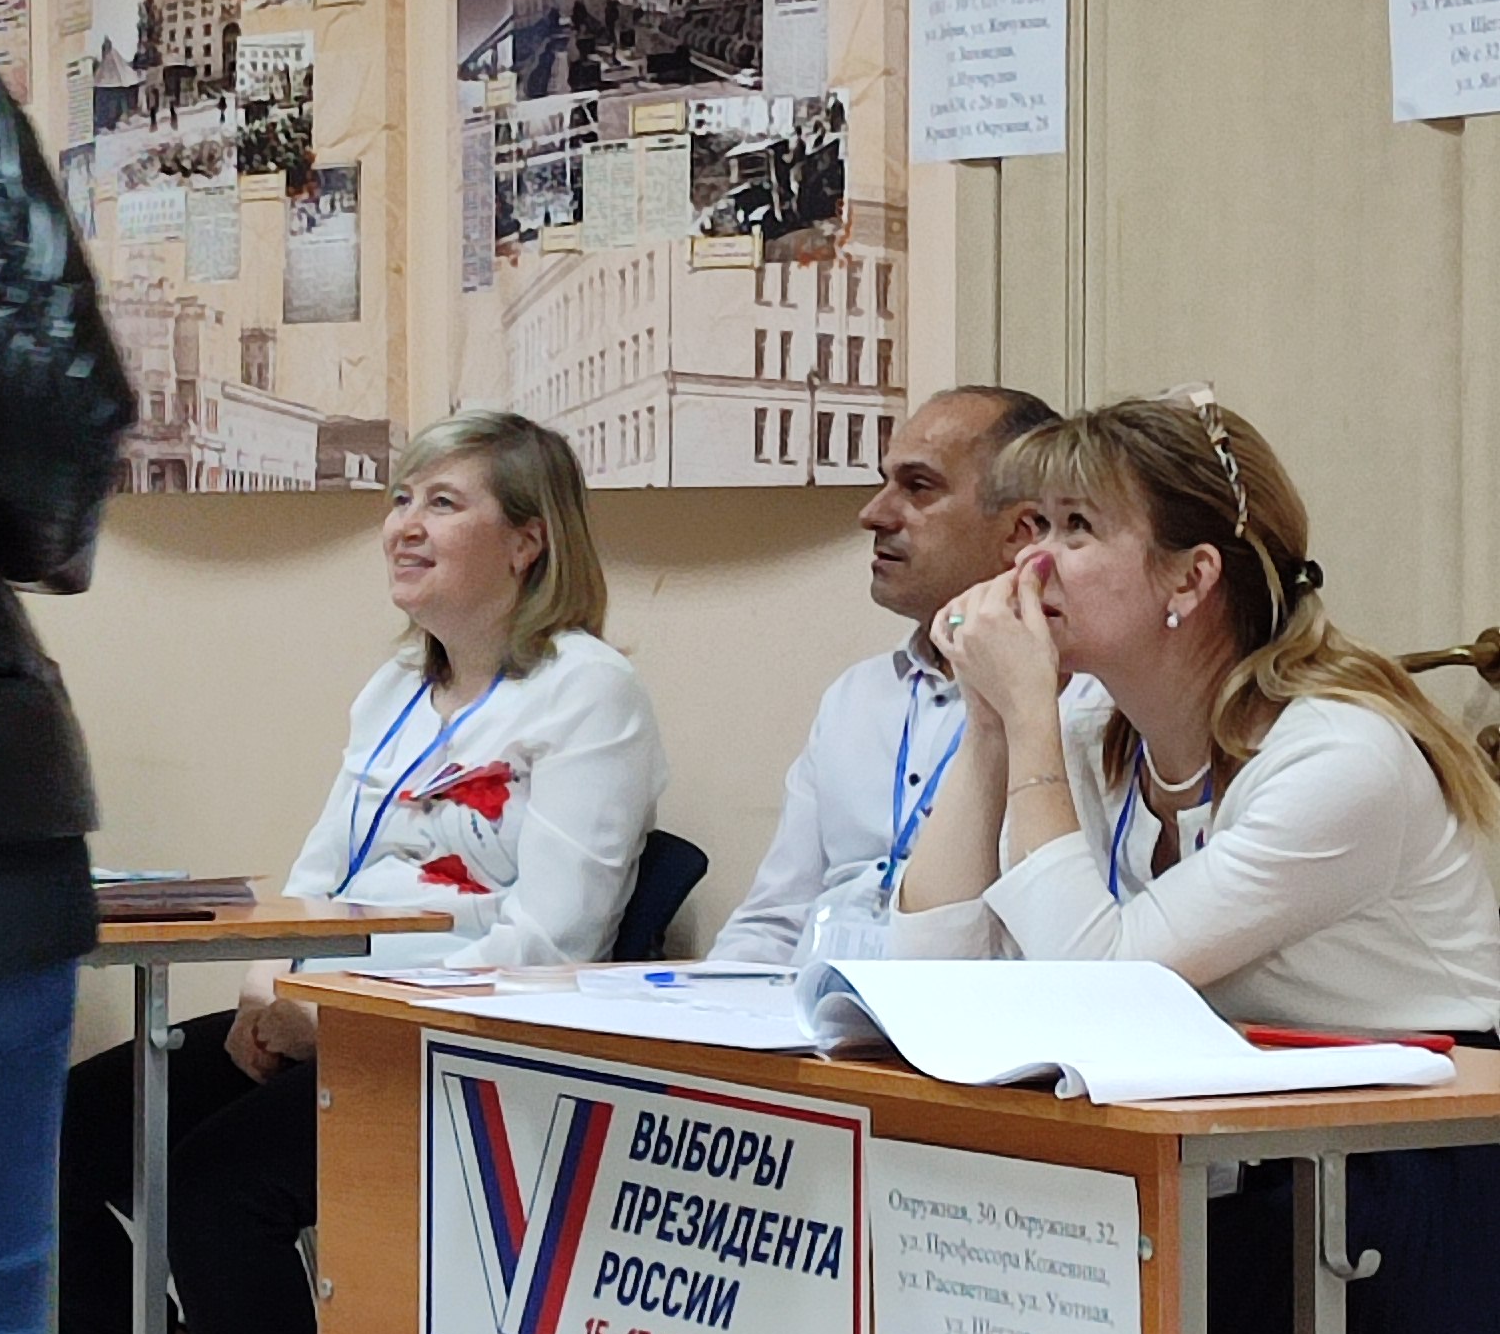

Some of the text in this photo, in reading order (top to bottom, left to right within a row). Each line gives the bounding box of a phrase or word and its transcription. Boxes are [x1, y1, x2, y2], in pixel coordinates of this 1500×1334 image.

[628, 1110, 795, 1190] ВЫБОРЫ
[610, 1180, 844, 1280] ПРЕЗИДЕНТА
[888, 1188, 1120, 1249] Окружная, 30, Окружная, 32,
[899, 1232, 922, 1255] ул.
[926, 1231, 1021, 1274] Профессора
[592, 1250, 741, 1331] РОССИИ
[898, 1269, 1115, 1327] ул. Рассветная, ул. Уютная,
